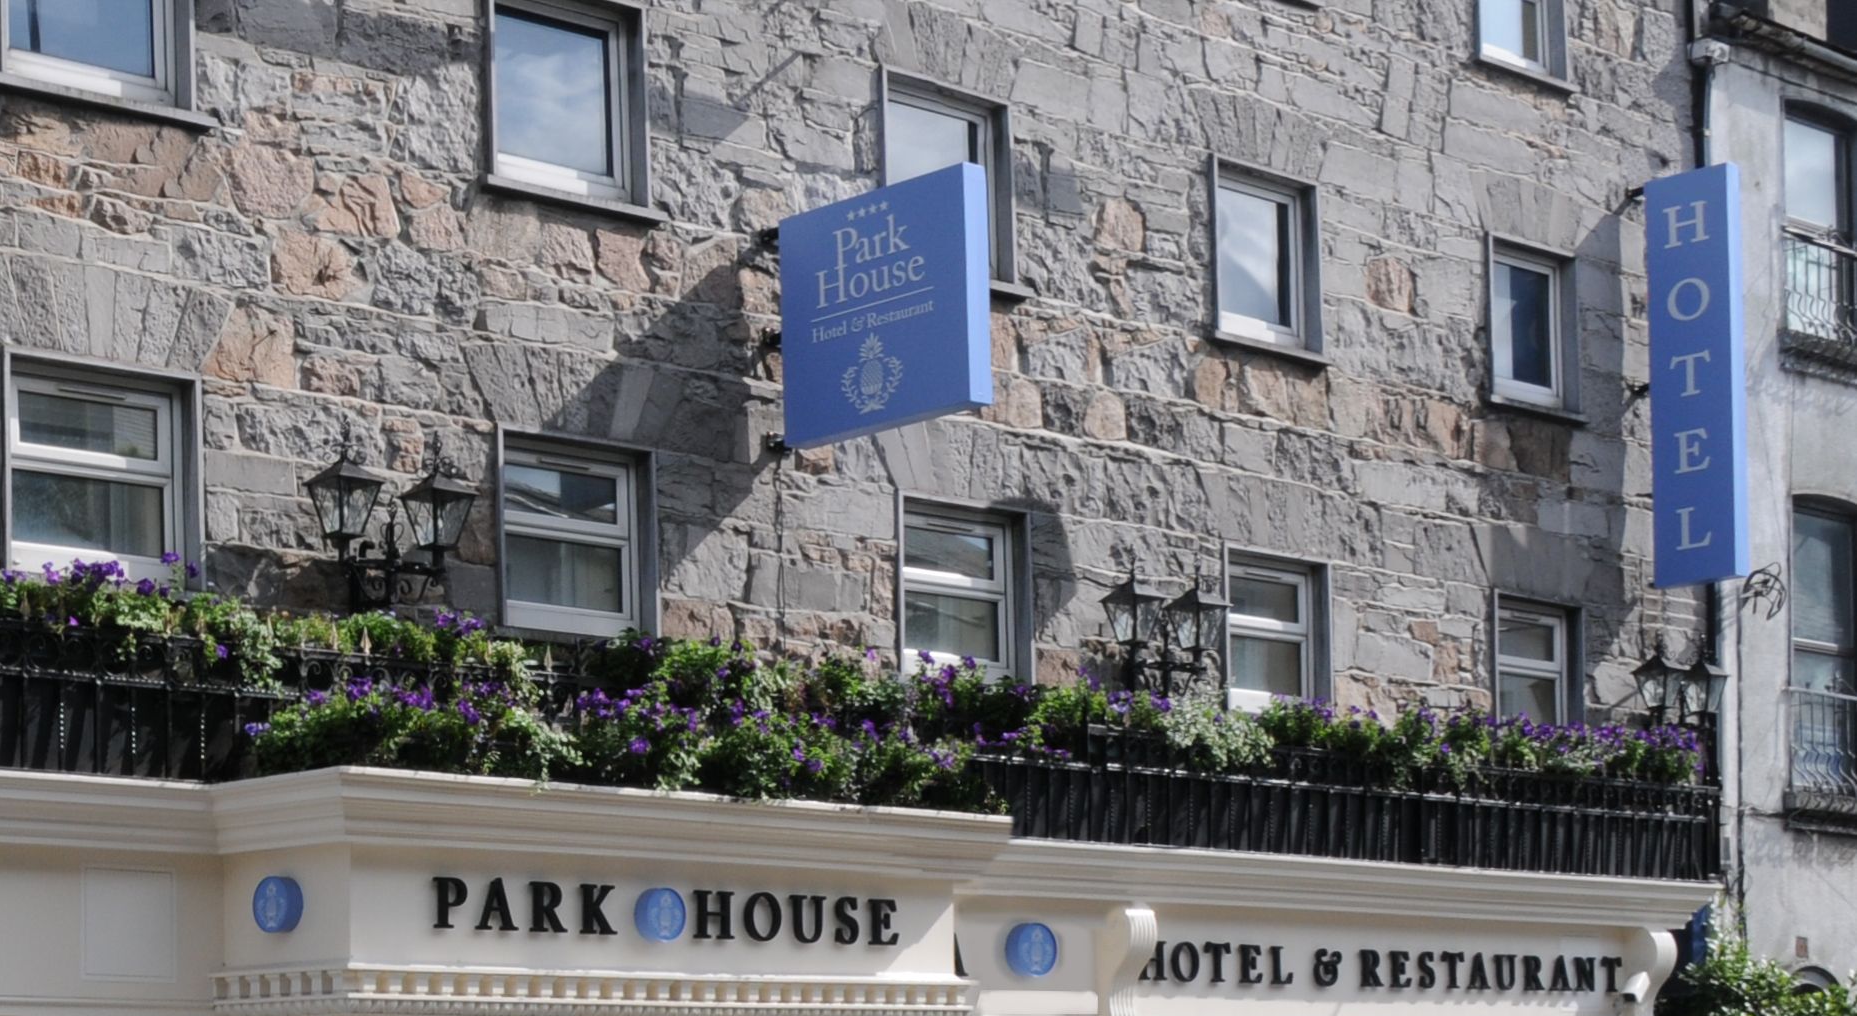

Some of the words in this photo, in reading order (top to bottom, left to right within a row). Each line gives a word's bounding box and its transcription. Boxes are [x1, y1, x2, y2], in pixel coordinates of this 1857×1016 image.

[832, 214, 910, 269] Park
[815, 256, 925, 309] House
[811, 320, 847, 343] Hotel
[851, 316, 864, 332] &
[866, 300, 934, 328] Restaurant
[1661, 200, 1712, 551] HOTEL
[433, 876, 618, 936] PARK
[692, 889, 901, 946] HOUSE
[1313, 948, 1343, 987] &
[1359, 949, 1623, 993] RESTAURANT
